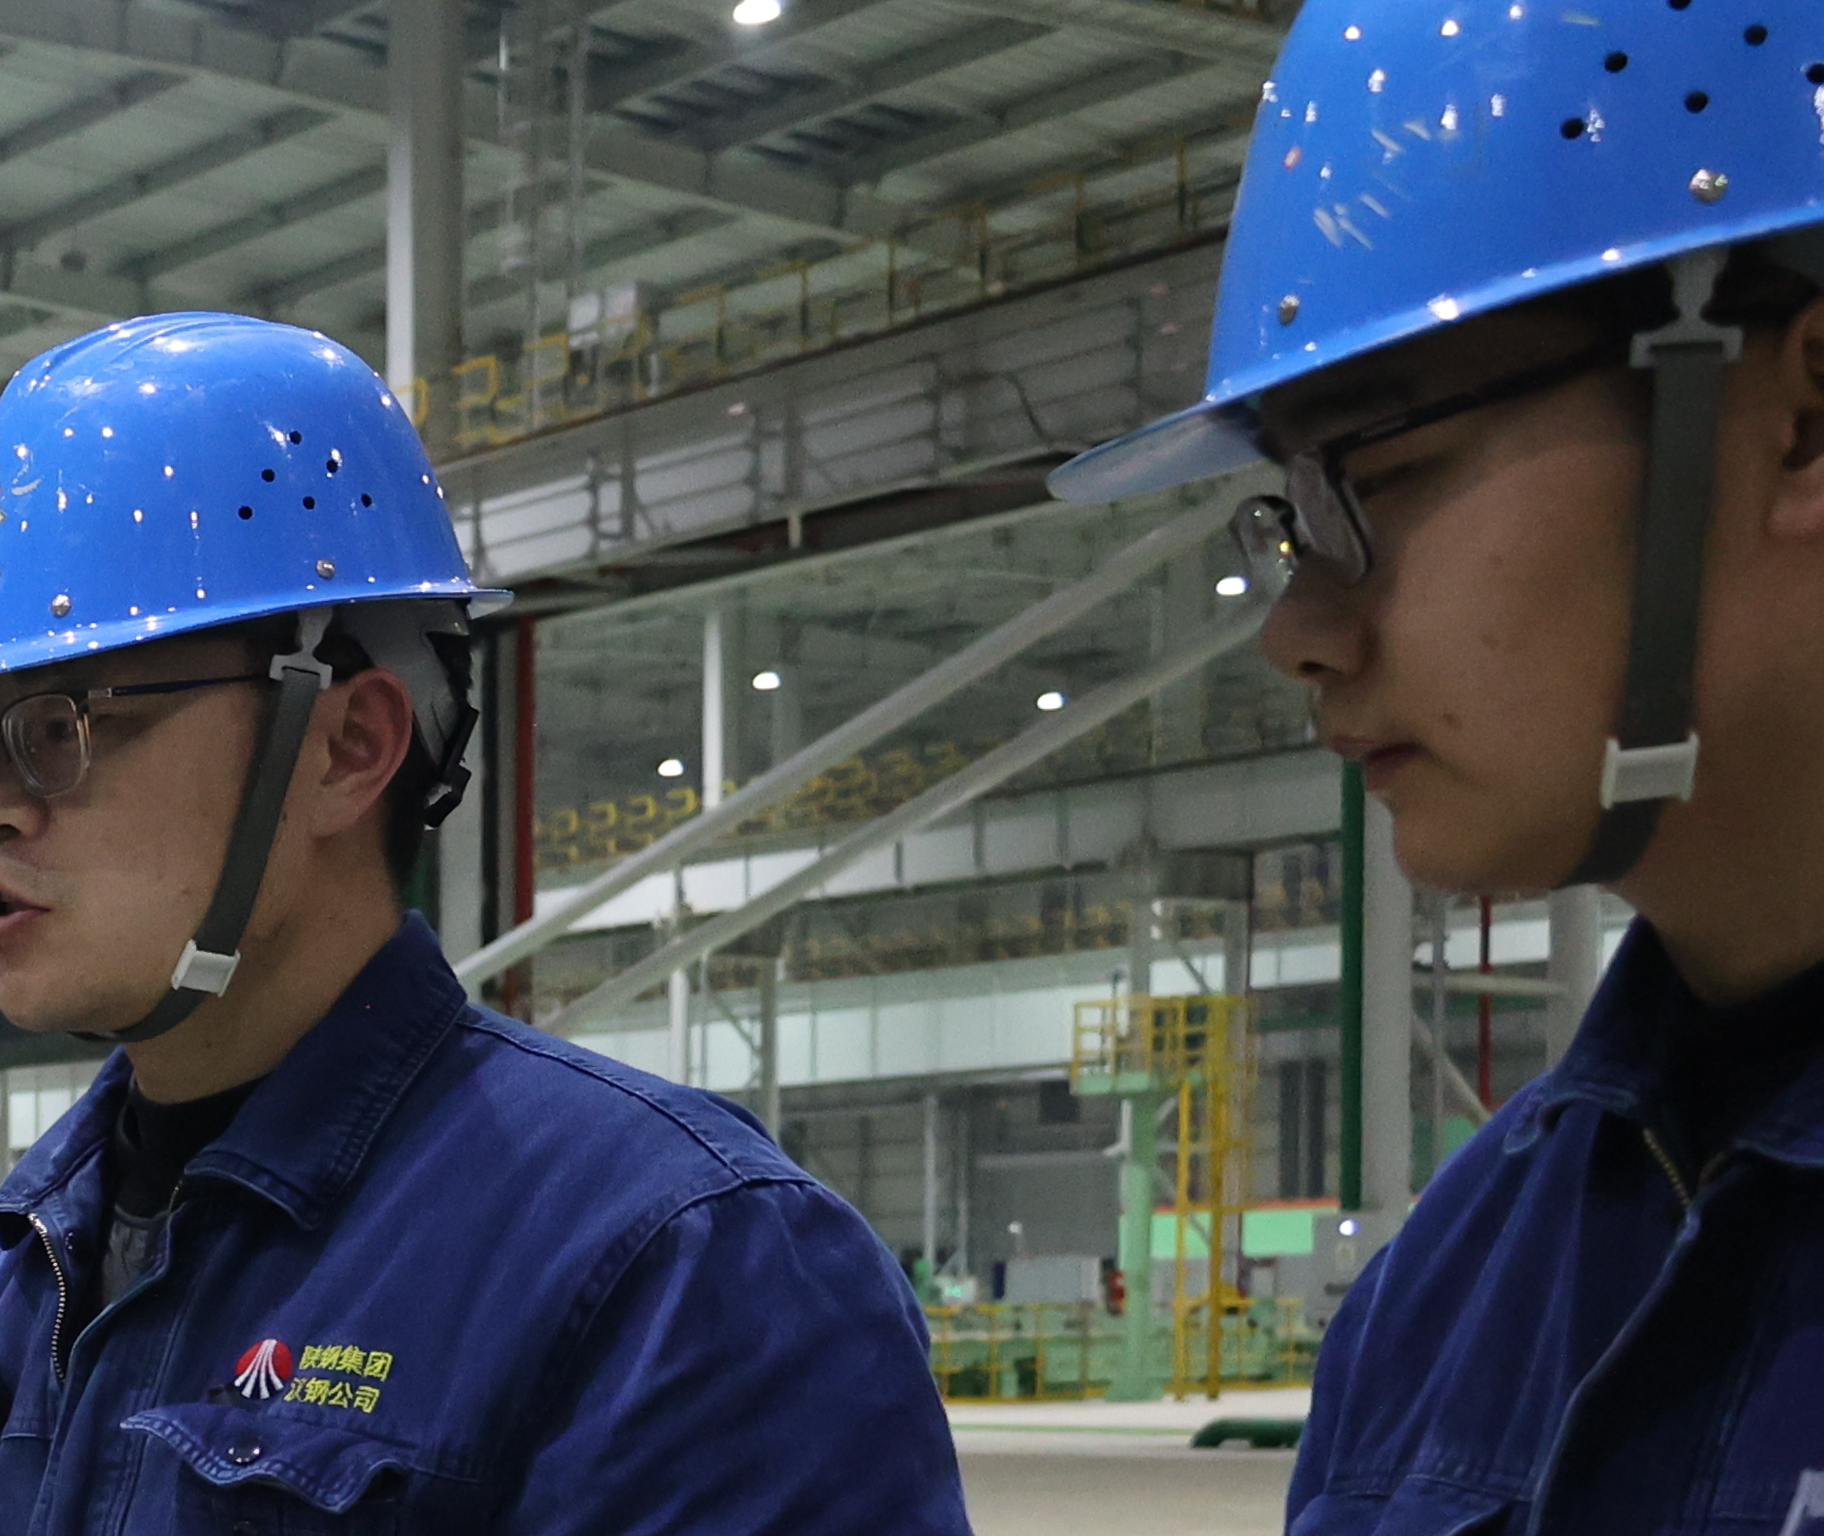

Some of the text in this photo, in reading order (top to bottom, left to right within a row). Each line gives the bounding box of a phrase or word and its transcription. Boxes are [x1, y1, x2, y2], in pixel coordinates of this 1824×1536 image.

[298, 1344, 393, 1382] 陕钢集团
[283, 1377, 380, 1413] 汉钢公司
